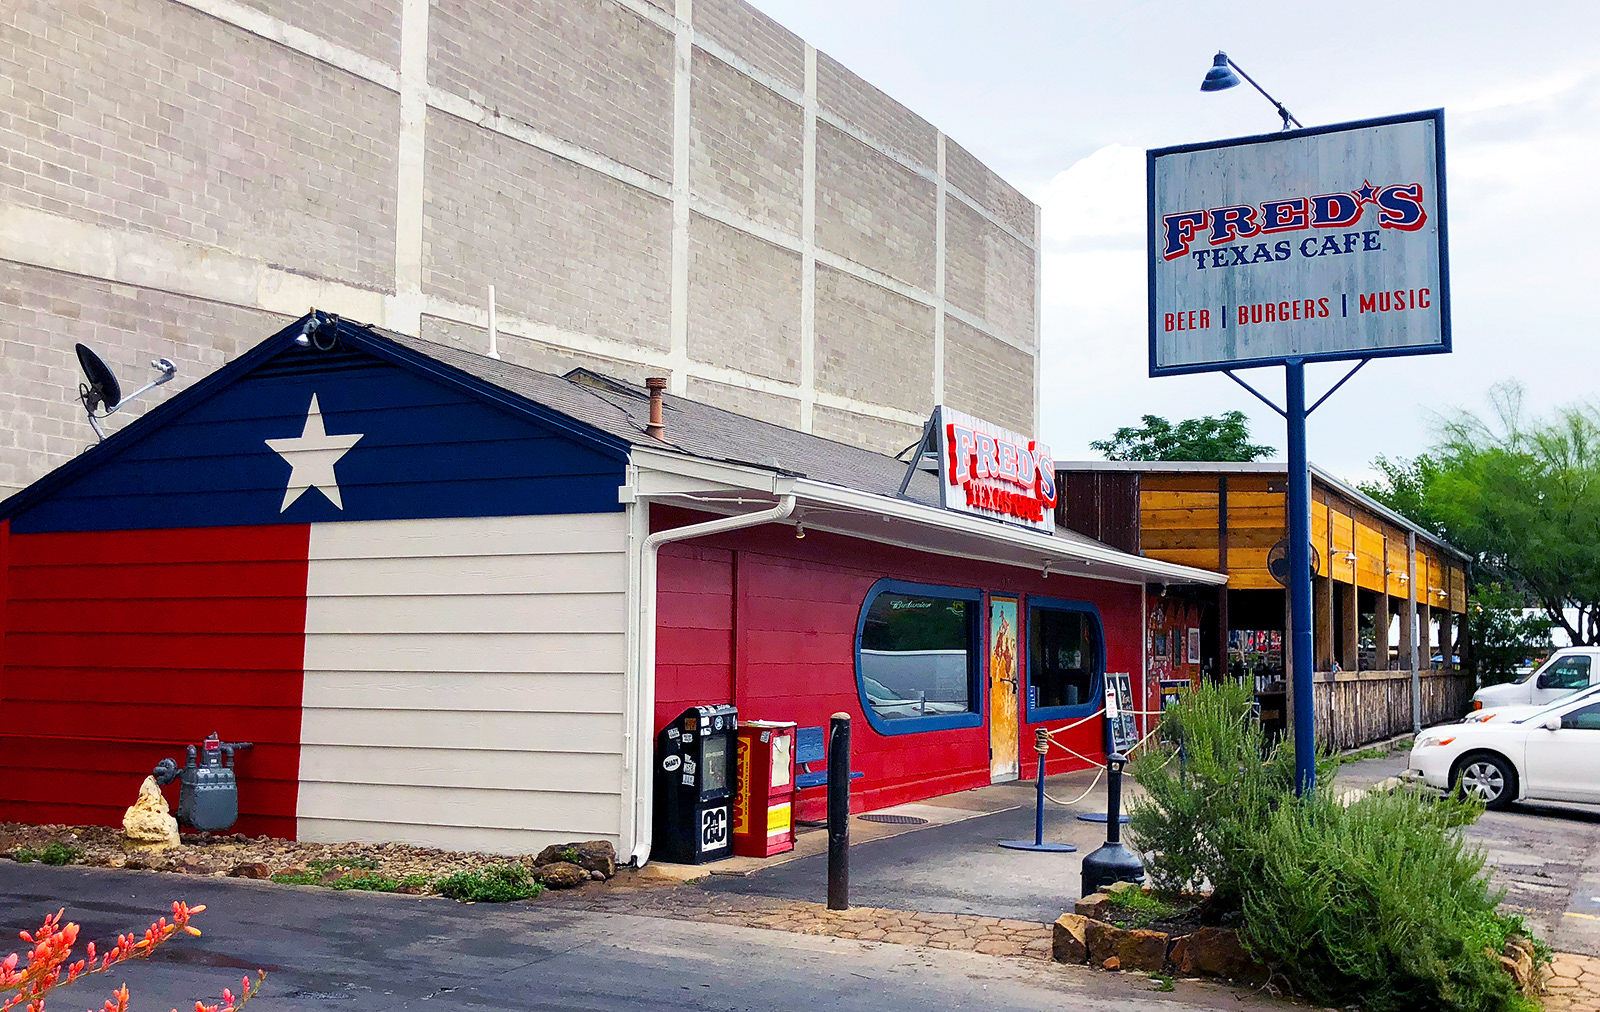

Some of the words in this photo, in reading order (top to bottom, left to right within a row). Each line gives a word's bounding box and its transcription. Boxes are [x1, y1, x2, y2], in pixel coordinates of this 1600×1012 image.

[1162, 180, 1427, 261] FRED'S
[1192, 240, 1291, 270] TEXAS
[1298, 230, 1381, 259] CAFE
[1165, 309, 1210, 332] BEER
[1238, 297, 1330, 326] BURGERS
[1359, 288, 1431, 314] MUSIC
[947, 424, 1057, 508] FRED'S
[963, 480, 1012, 514] TEXAS
